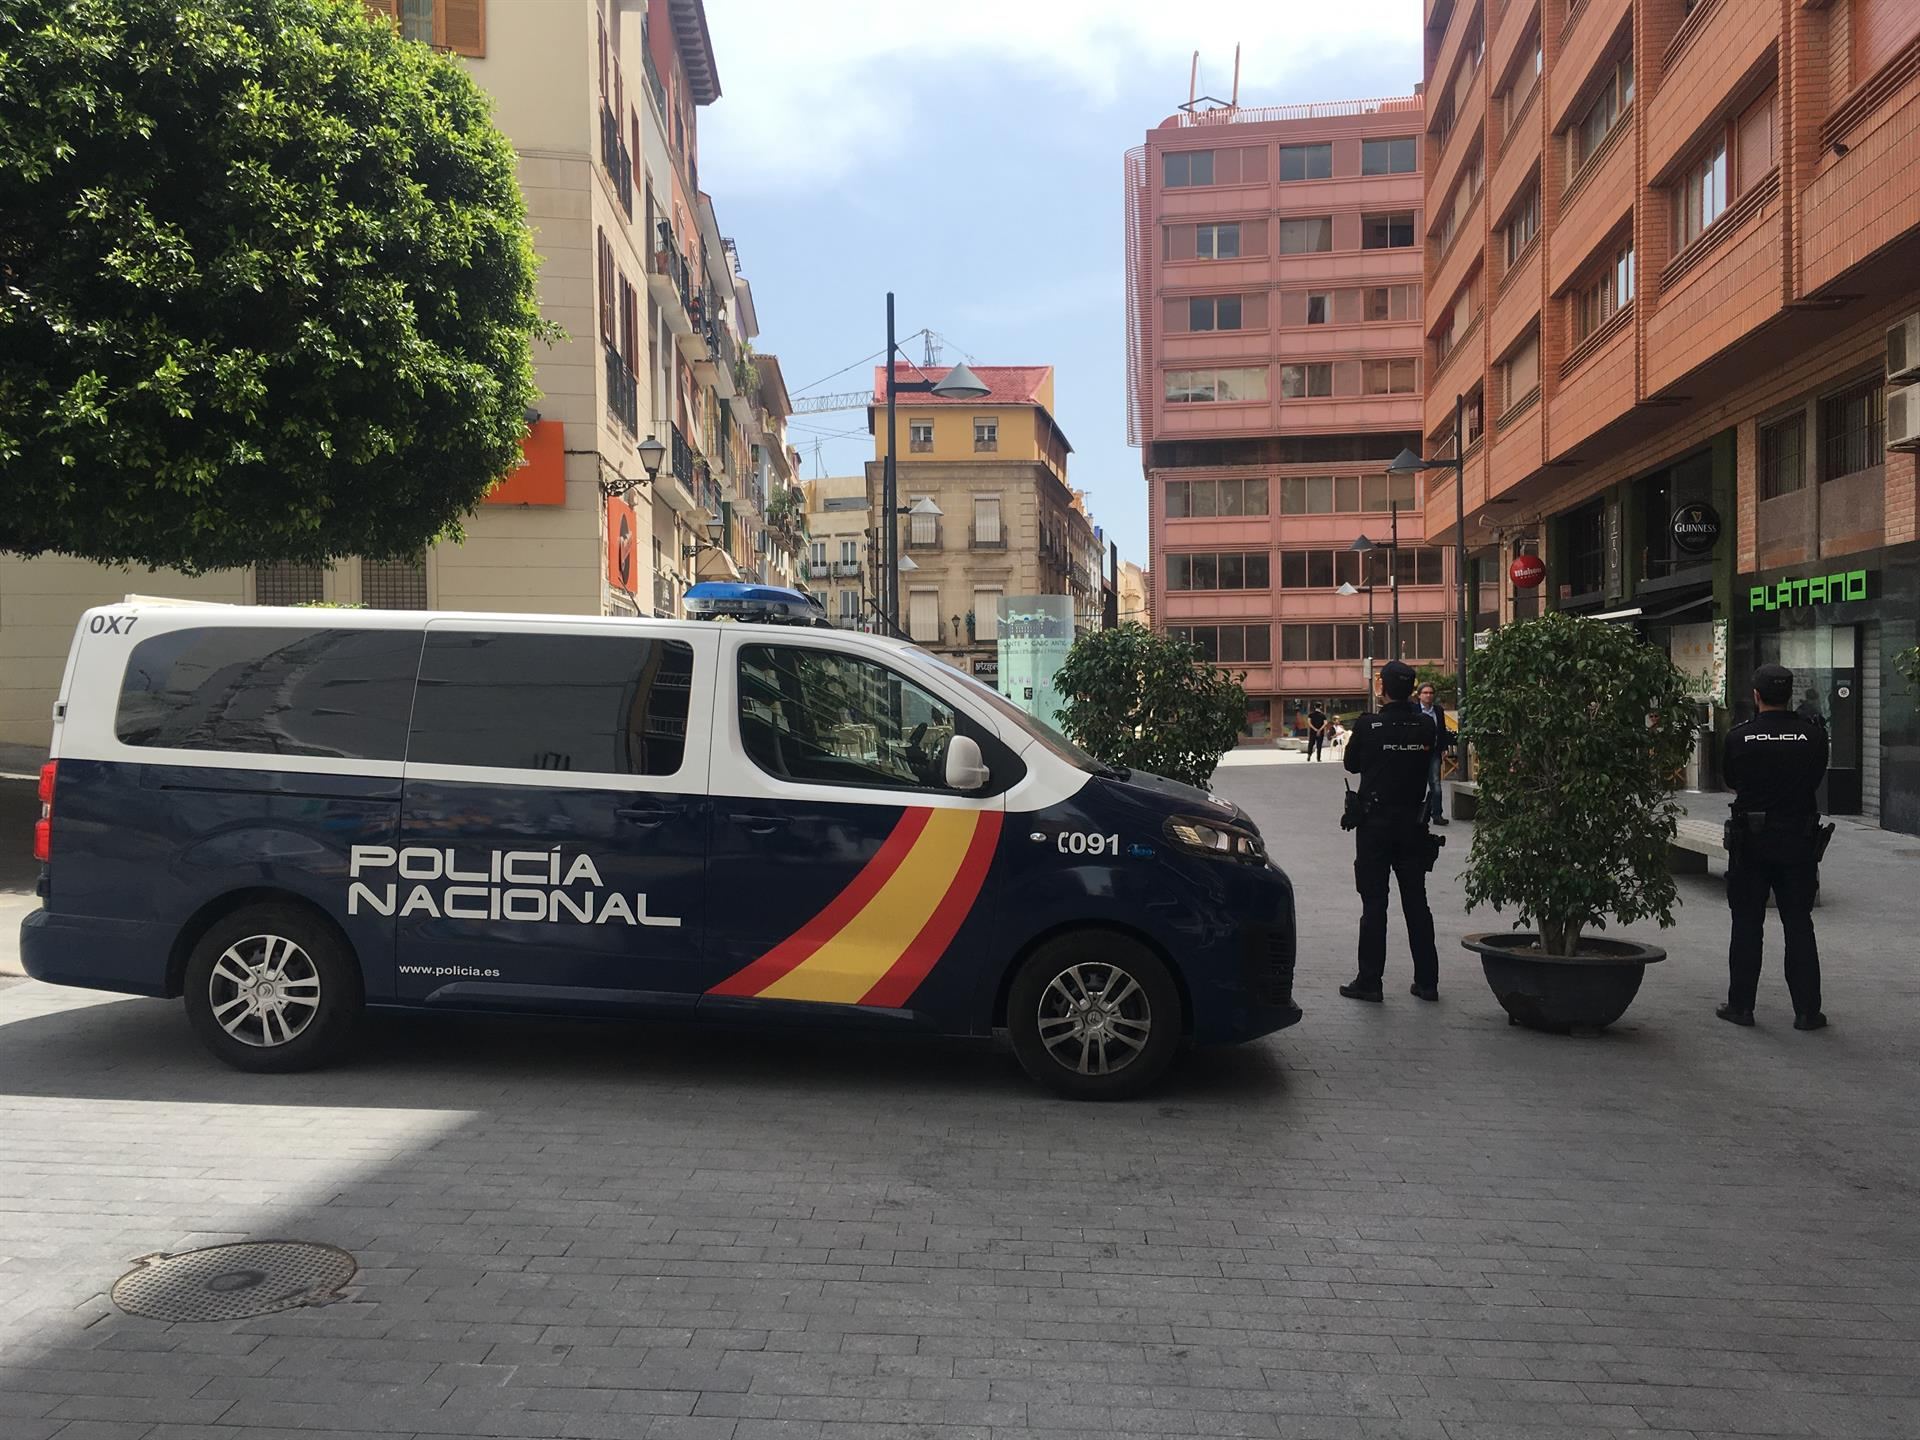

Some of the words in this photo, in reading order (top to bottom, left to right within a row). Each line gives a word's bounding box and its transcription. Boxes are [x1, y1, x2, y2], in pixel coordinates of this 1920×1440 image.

[1674, 522, 1717, 533] GUINNESS
[1744, 732, 1808, 743] POLICIA
[1383, 743, 1425, 751] POLICIA
[1068, 831, 1119, 856] 091
[350, 844, 604, 887] POLICÍA
[348, 881, 682, 927] NACIONAL
[398, 964, 500, 977] www.policia.es
